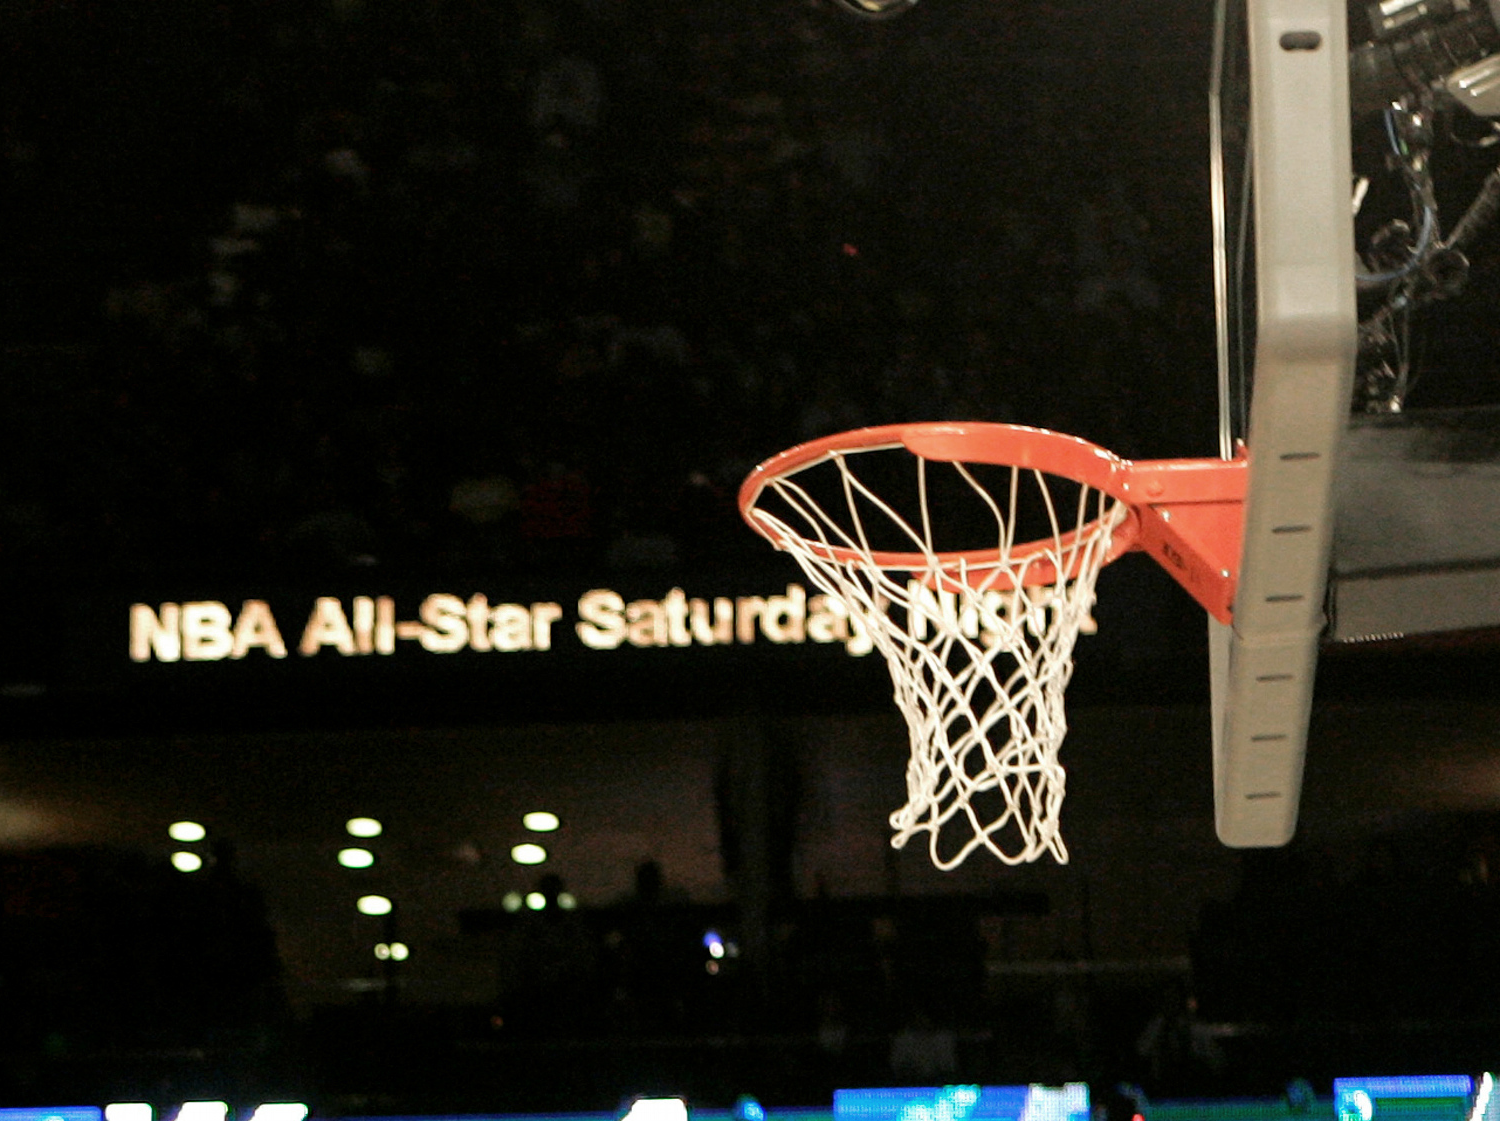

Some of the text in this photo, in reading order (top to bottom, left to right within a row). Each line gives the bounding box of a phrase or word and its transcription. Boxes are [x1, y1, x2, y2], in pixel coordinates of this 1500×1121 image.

[129, 600, 288, 663] NBA
[299, 593, 563, 657] All-Star
[576, 583, 888, 657] Saturday
